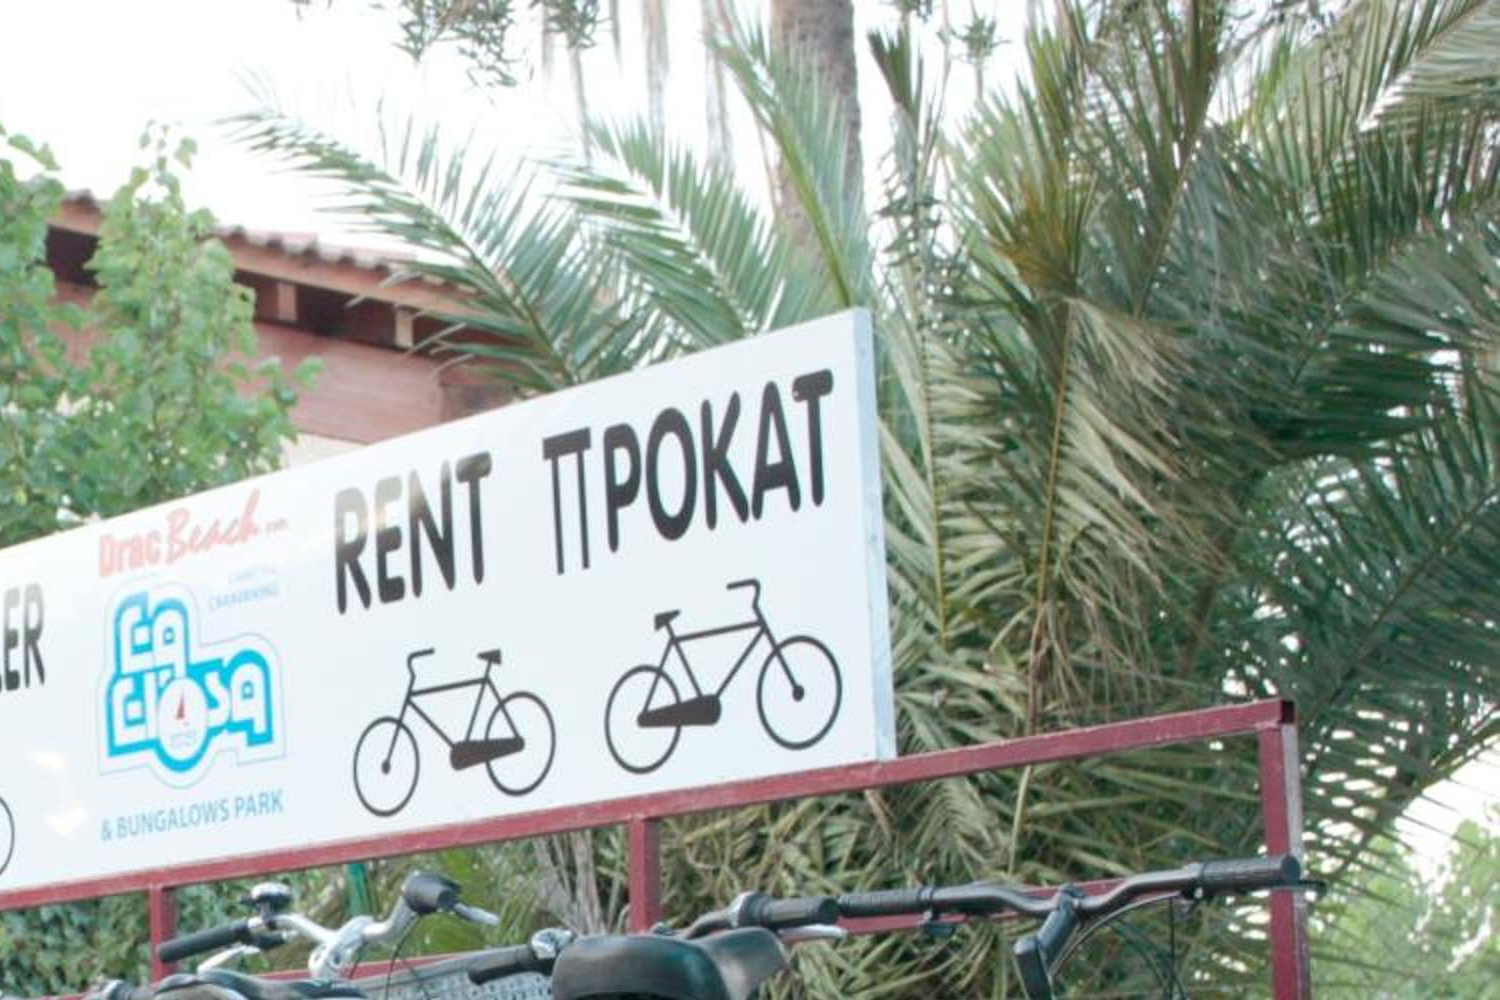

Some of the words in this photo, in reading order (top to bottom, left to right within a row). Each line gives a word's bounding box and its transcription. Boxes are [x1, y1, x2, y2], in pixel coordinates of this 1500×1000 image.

[334, 451, 492, 614] RENT
[542, 368, 833, 575] ПРОКАТ
[101, 819, 113, 842] &
[116, 798, 230, 839] BUNGALOWS
[234, 788, 284, 819] PARK
